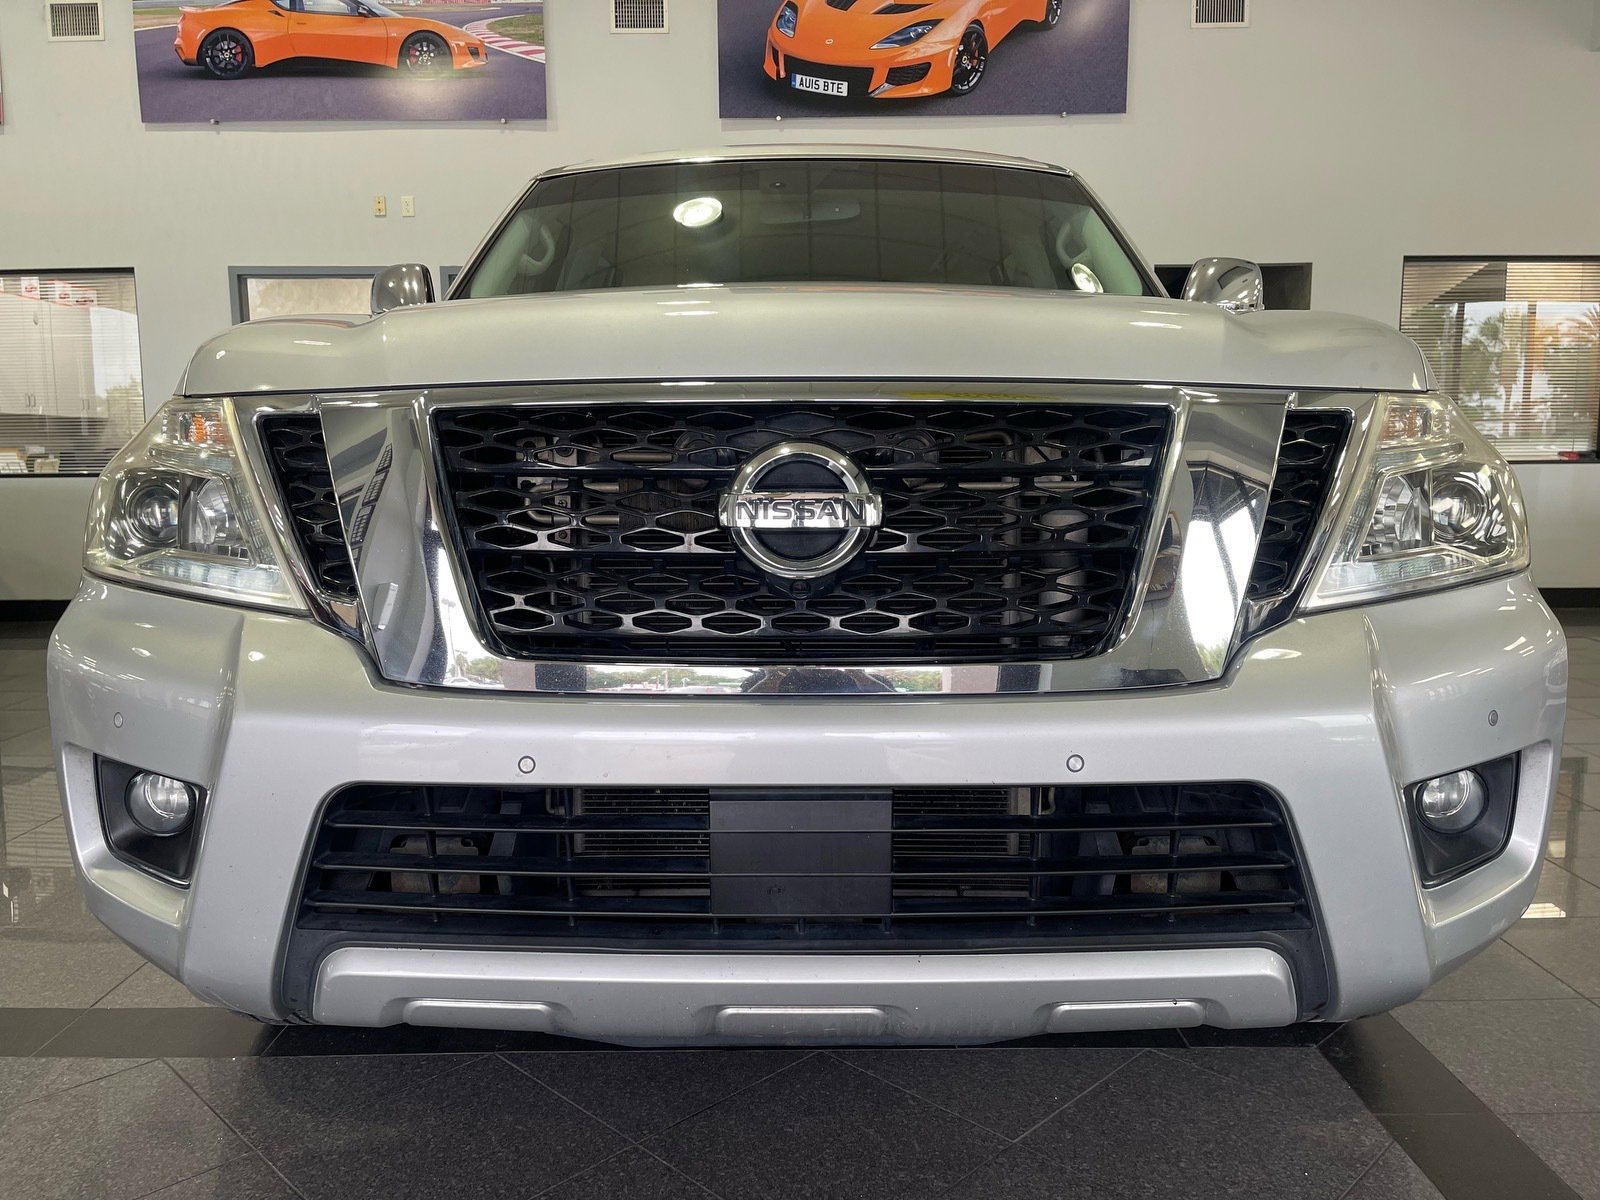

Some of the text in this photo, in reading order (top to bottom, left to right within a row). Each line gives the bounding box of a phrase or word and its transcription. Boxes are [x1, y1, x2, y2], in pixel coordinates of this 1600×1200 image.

[799, 77, 843, 94] AU15 BTE
[736, 499, 866, 522] NISSAN
